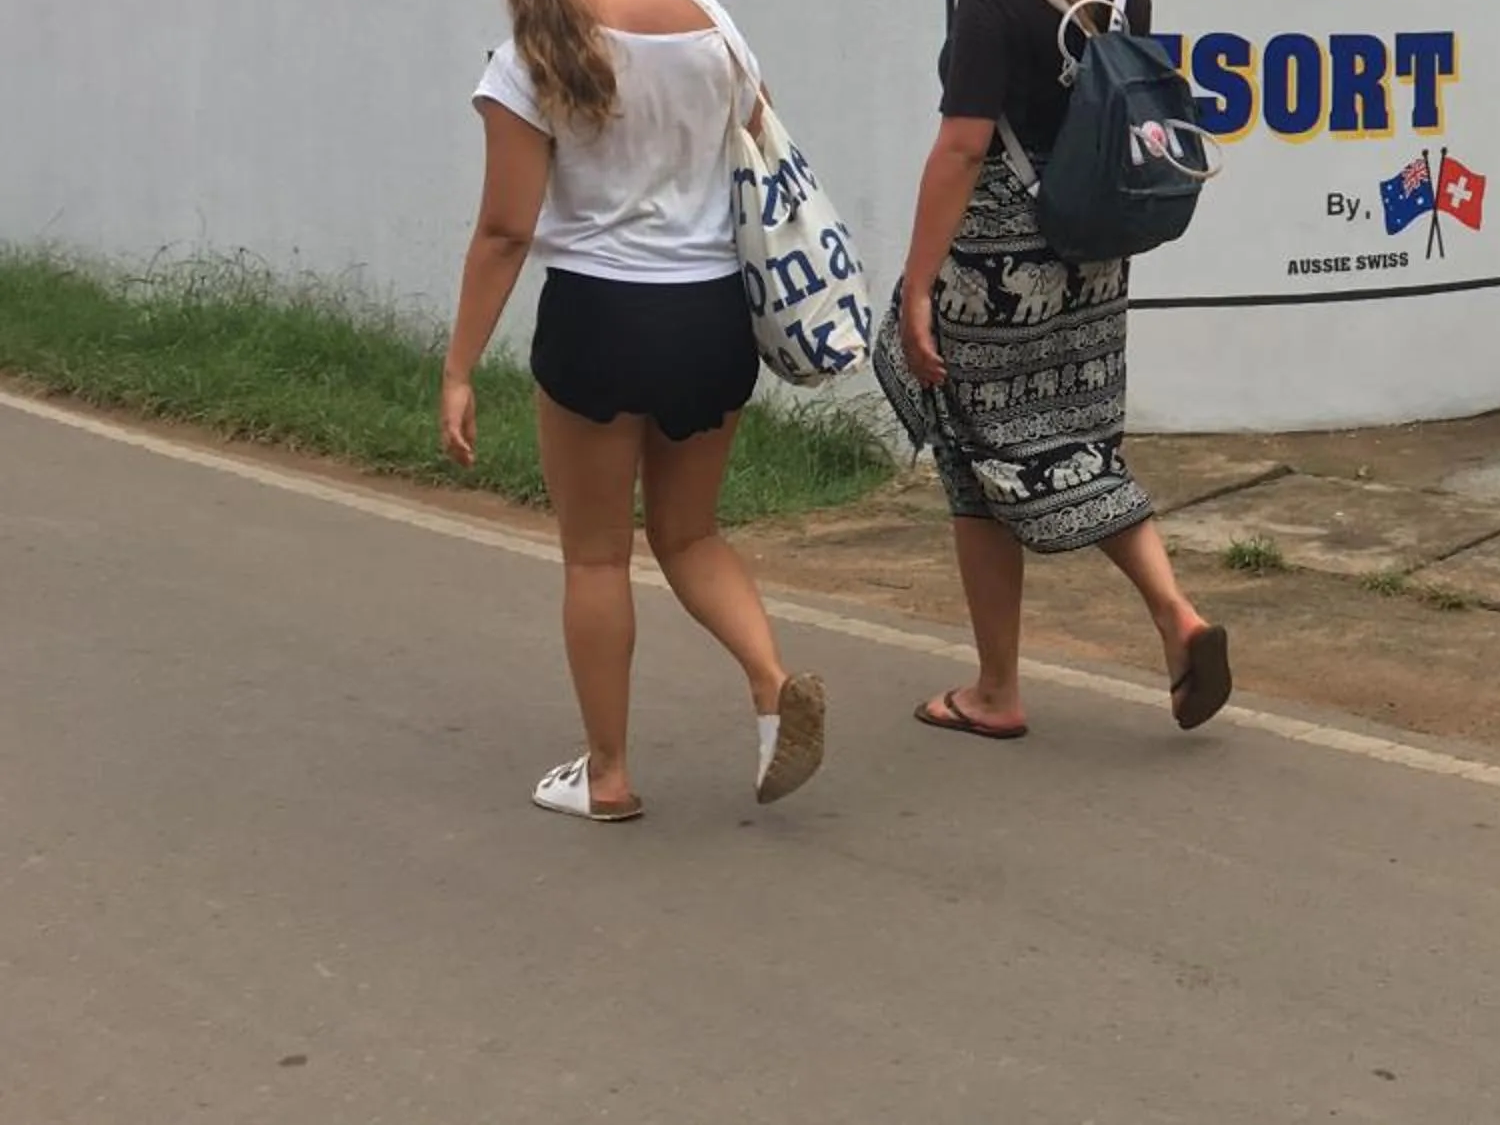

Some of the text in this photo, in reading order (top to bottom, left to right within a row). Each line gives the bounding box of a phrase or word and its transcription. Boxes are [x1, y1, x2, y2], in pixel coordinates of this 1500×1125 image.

[1150, 32, 1459, 143] SORT
[1287, 252, 1409, 276] AUSSIE SWISS
